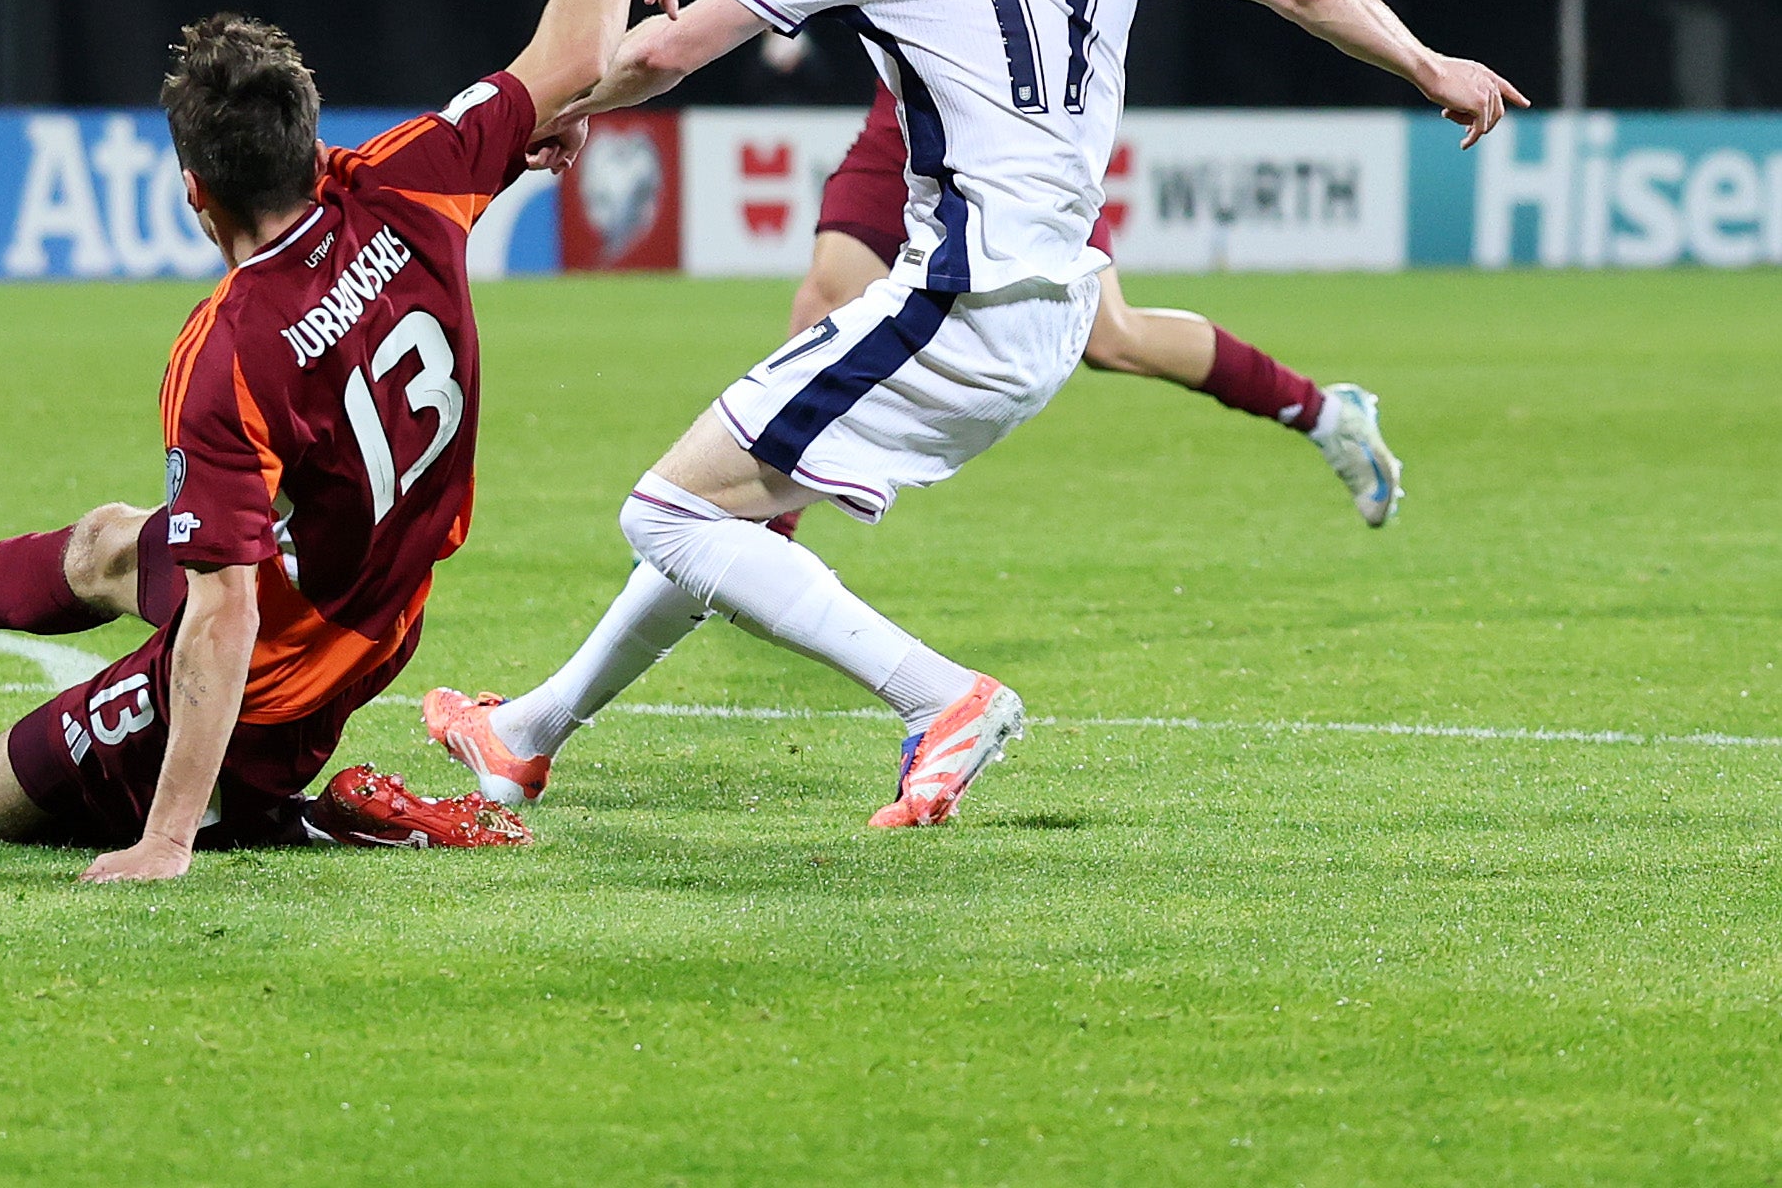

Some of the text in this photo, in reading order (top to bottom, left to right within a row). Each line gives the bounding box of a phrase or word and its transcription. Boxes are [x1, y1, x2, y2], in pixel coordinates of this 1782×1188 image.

[3, 114, 224, 276] Ato
[281, 223, 413, 368] JURKOVSKIS
[344, 310, 464, 526] 13
[89, 673, 155, 745] 13
